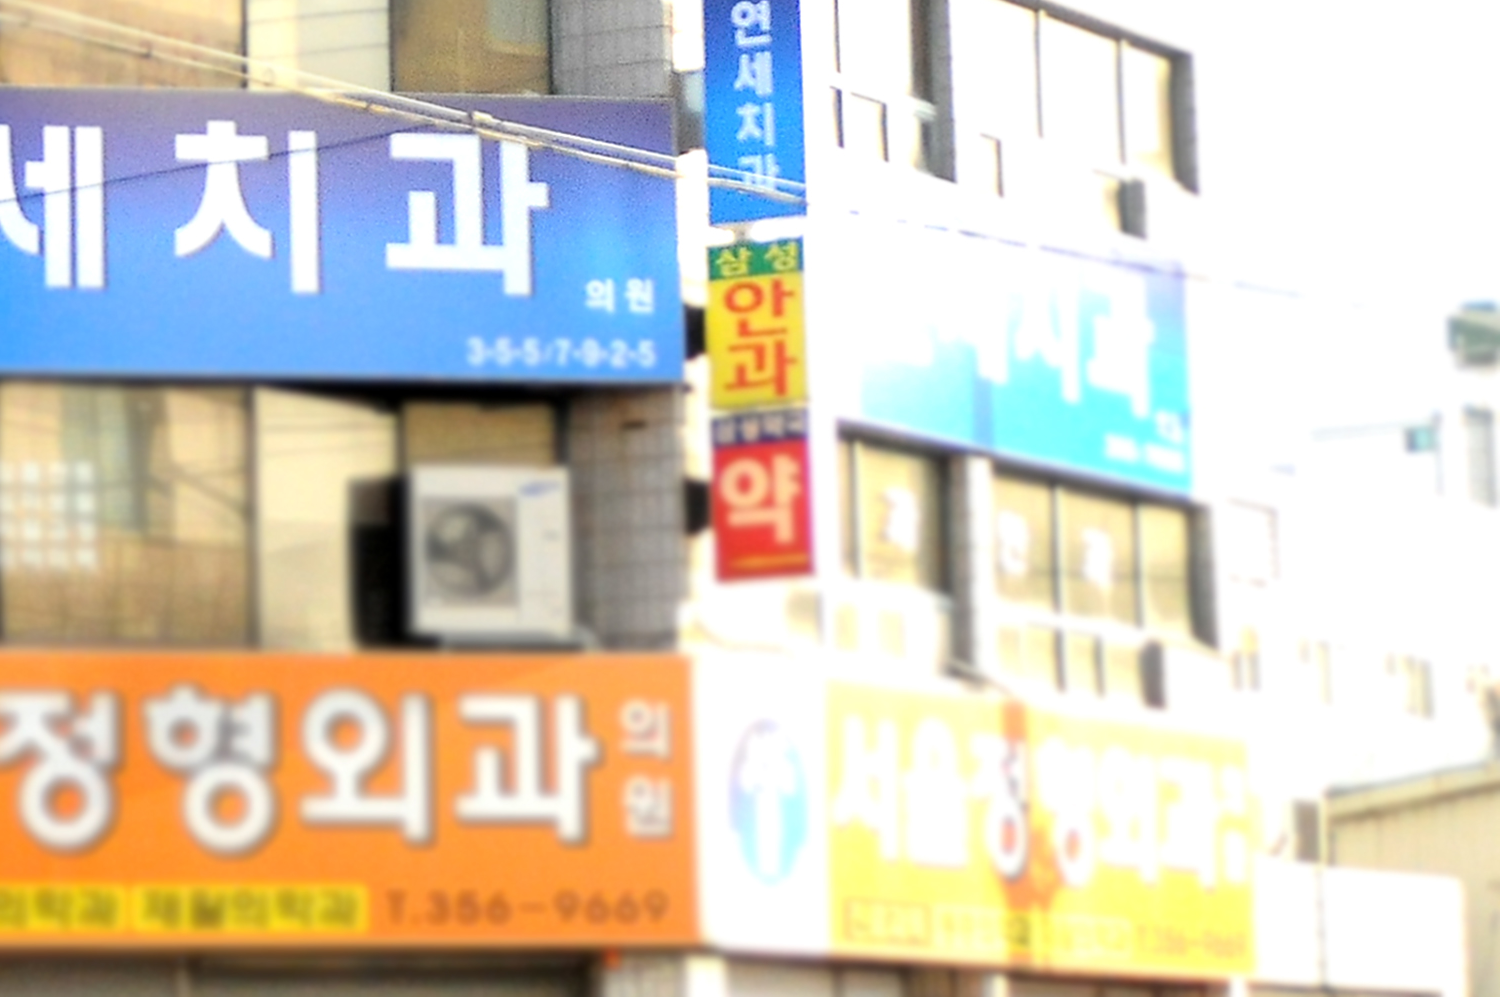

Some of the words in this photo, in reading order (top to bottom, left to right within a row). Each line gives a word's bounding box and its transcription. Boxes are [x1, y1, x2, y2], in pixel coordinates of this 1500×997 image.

[730, 0, 778, 194] 연세치과
[584, 277, 656, 314] 의원
[714, 242, 800, 278] 삼성
[723, 277, 798, 397] 안과
[719, 454, 804, 545] 약
[620, 698, 674, 840] 의원
[386, 888, 672, 928] T.356-9669
